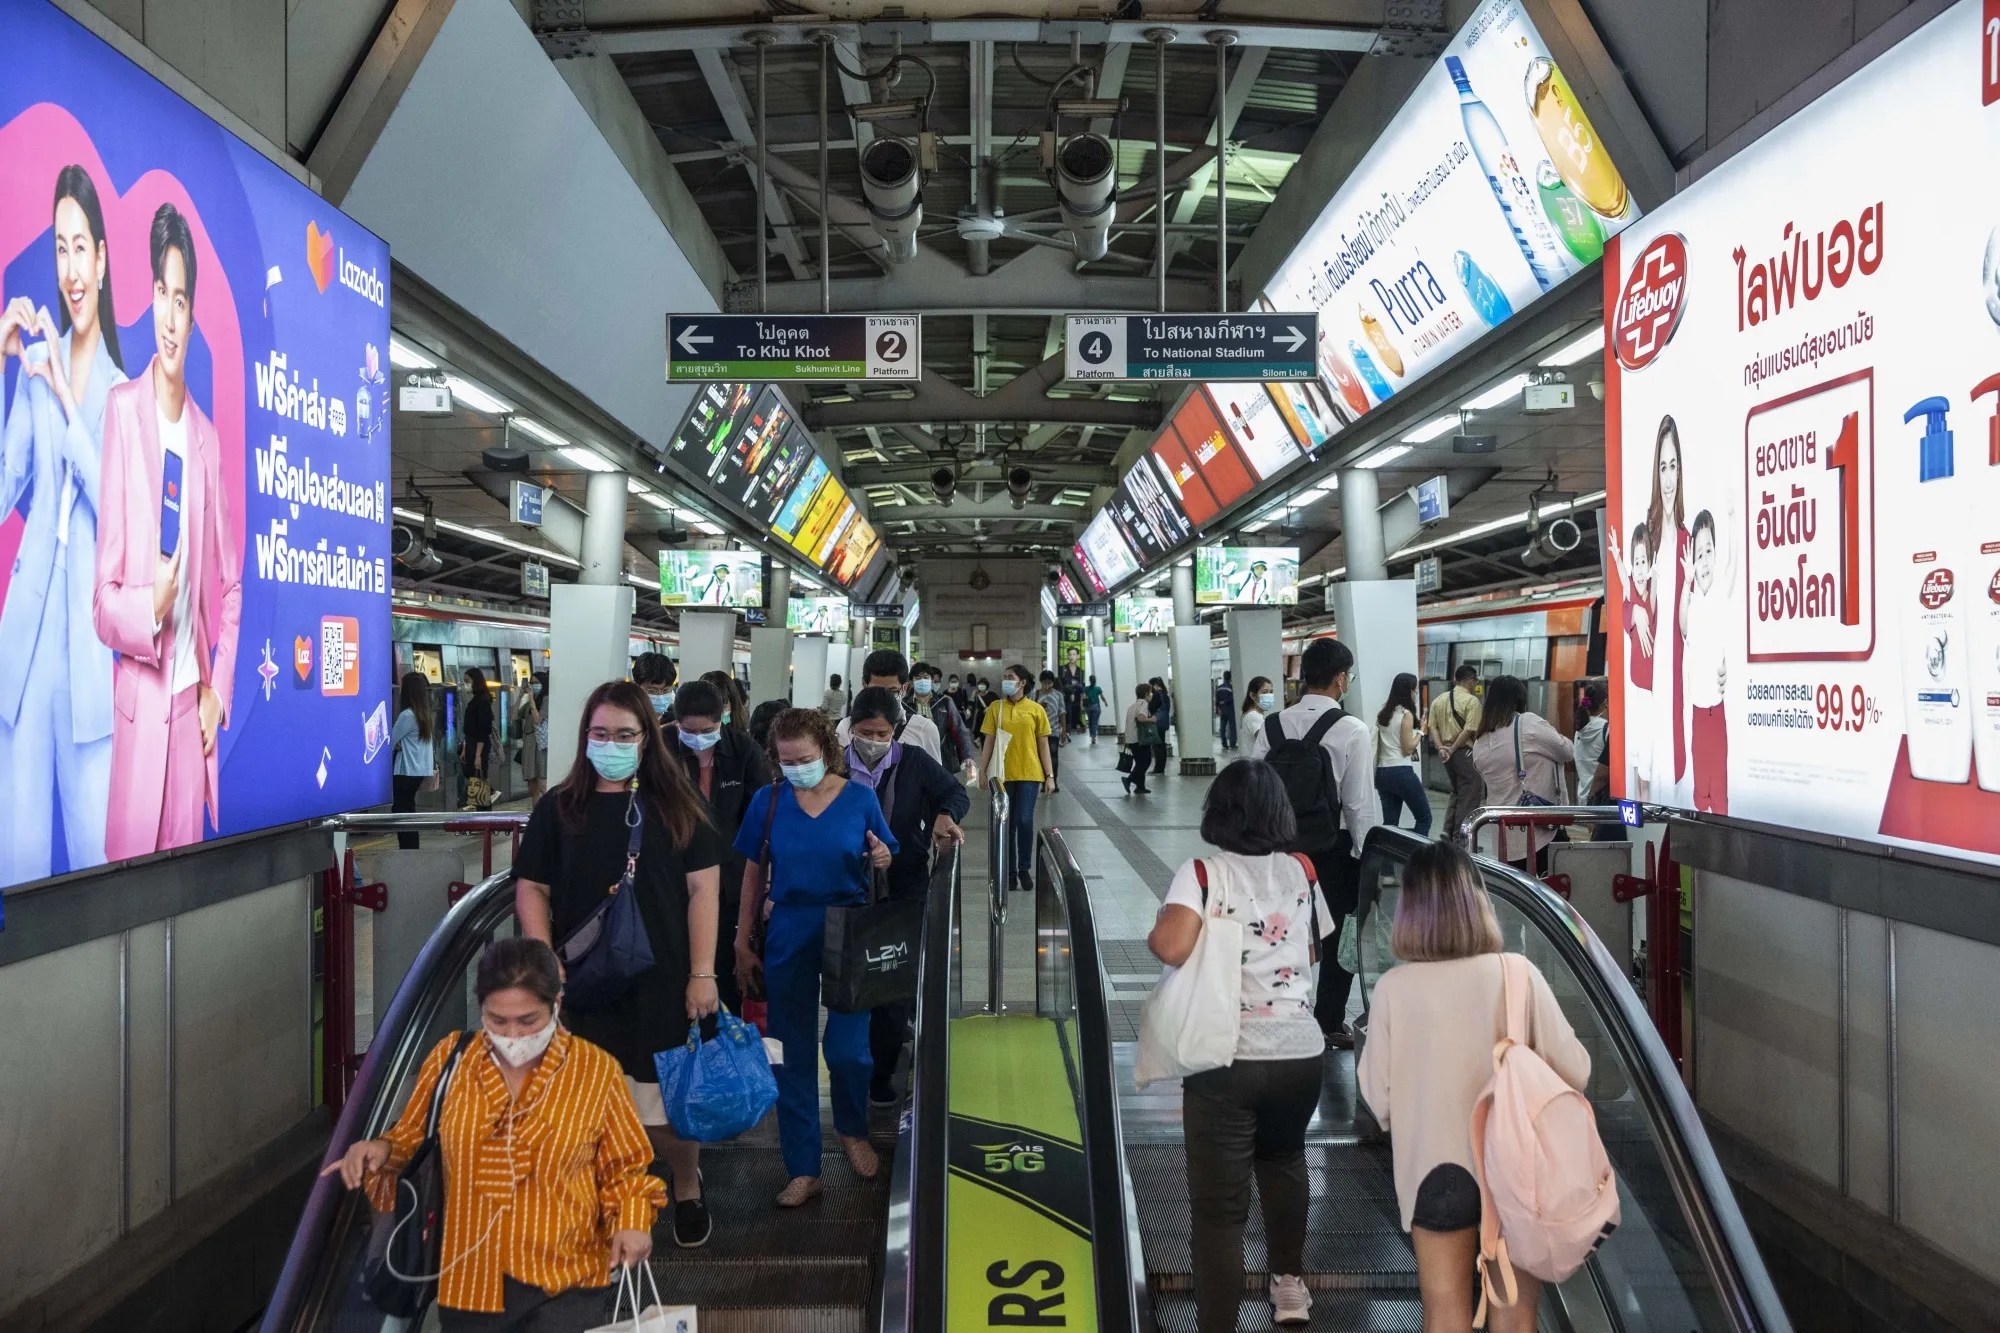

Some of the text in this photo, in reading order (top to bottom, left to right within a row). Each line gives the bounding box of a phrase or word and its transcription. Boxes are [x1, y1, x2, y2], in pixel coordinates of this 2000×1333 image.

[340, 247, 384, 308] Lazada
[1732, 201, 1883, 332] ไลฟ์บอย
[1620, 276, 1683, 329] Lifebuoy
[869, 318, 915, 326] ชานชาลา
[1074, 317, 1117, 325] ชานชาลา
[1142, 318, 1265, 340] ไปสนามกีฬาฯ
[756, 322, 809, 344] ไปคูคต
[1409, 311, 1464, 358] VITAMIN WATER
[737, 346, 831, 358] To Khu Khot
[883, 334, 900, 359] 2
[1088, 338, 1103, 358] 4
[1143, 347, 1265, 358] To National Stadium
[1744, 311, 1873, 390] กลุ่มแบรนด์สุขอนามัย
[676, 363, 728, 377] สายสุขุมวิท
[795, 365, 860, 373] Sukhumvit Line
[873, 367, 909, 376] Platform
[1076, 370, 1115, 378] Platform
[1143, 364, 1191, 378] สายสีลม
[1262, 369, 1308, 377] Silom Line
[255, 350, 326, 430] ฟรีค่าส่ง
[1756, 431, 1816, 477] ยอดขาย
[255, 434, 374, 520] ฟรีคูปองส่วนลด
[1757, 484, 1816, 550] อันดับ
[1826, 411, 1860, 626] 1
[256, 518, 373, 592] ฟรีการคืนสินค้า
[1758, 554, 1836, 622] ของโลก
[1922, 582, 1952, 595] Lifebuoy
[1747, 679, 1813, 701] ช่วยลดการสะสม
[1748, 708, 1813, 729] ของแบคทีเรียได้ถึง
[984, 1152, 1045, 1173] 5G
[986, 1260, 1067, 1327] RS
